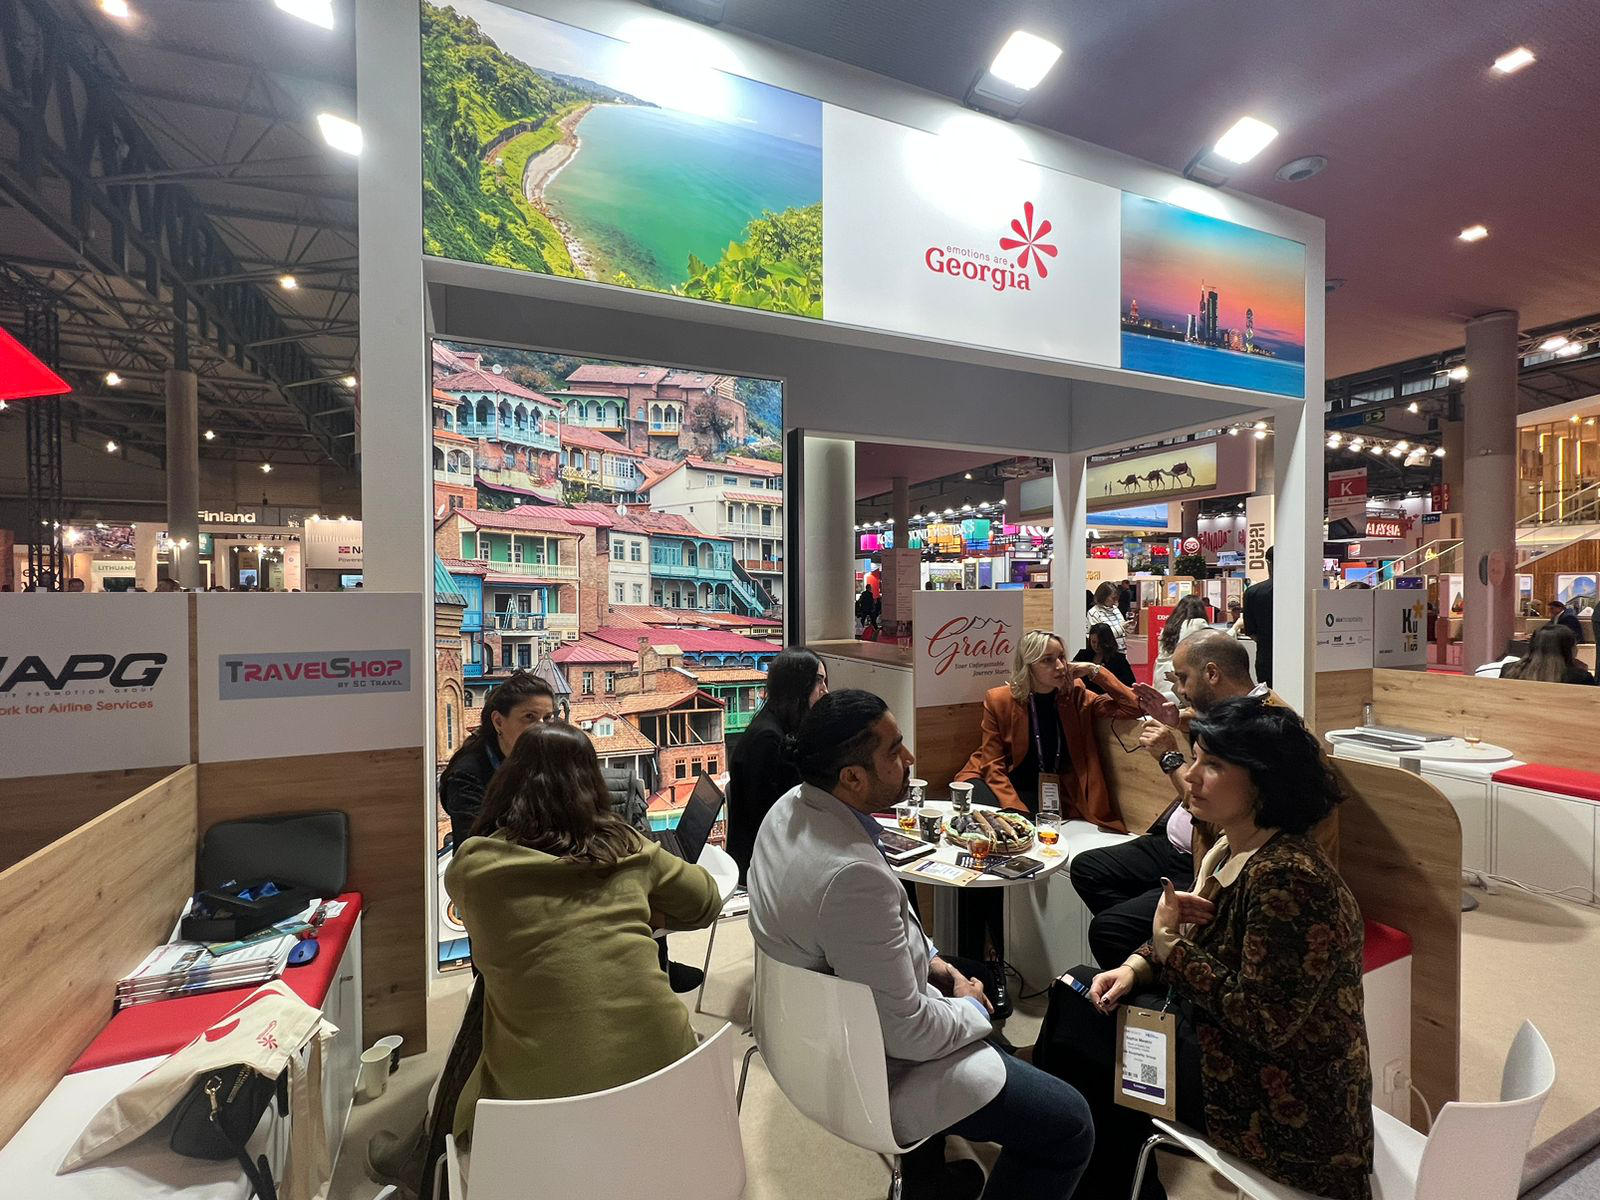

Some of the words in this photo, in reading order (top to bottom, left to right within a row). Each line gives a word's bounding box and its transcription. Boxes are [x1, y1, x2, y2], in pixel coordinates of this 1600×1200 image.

[947, 244, 990, 262] emotions
[993, 255, 1008, 265] are
[925, 247, 1031, 291] Georgia
[1341, 481, 1352, 496] K
[926, 616, 1015, 676] Grata
[25, 704, 45, 715] for
[48, 702, 93, 714] Airline
[96, 699, 154, 711] Services
